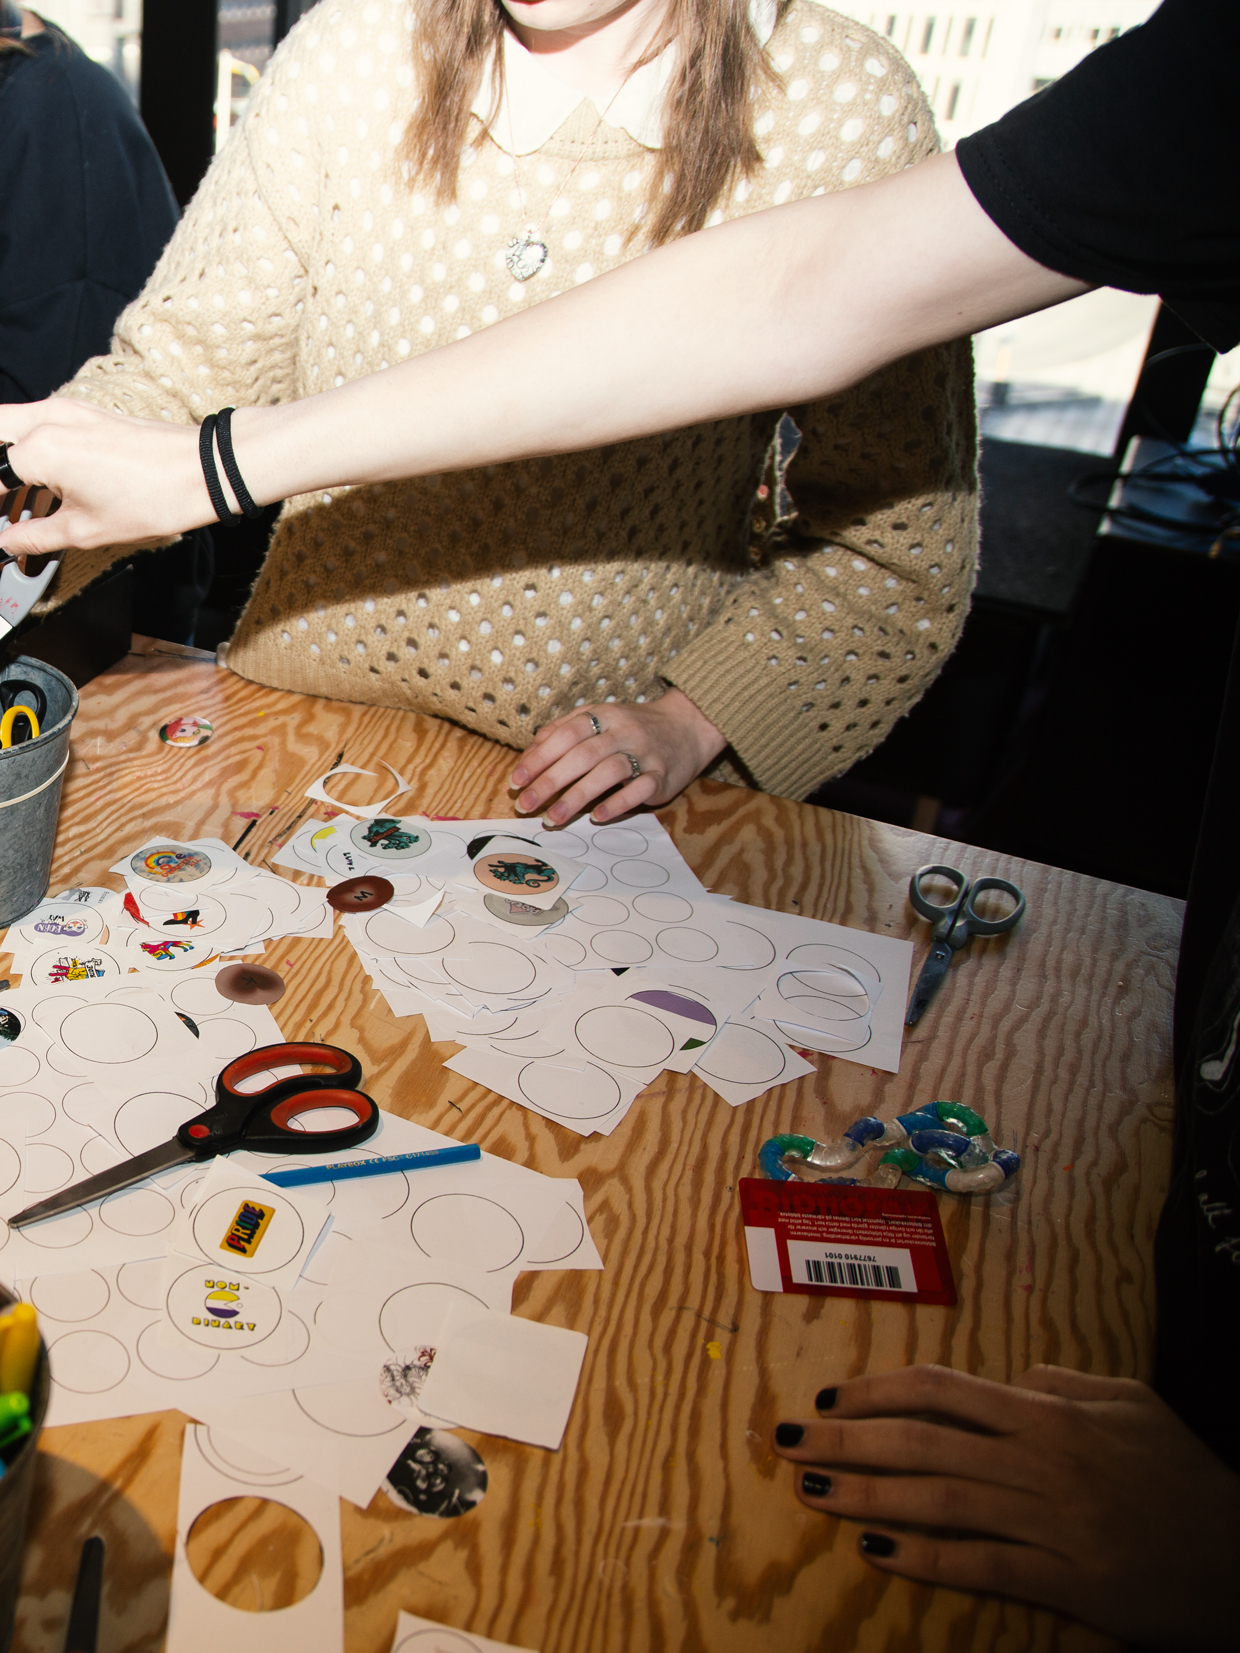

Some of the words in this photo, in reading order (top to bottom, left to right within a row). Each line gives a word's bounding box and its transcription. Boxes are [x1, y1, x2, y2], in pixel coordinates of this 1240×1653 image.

[37, 923, 61, 934] BORN
[325, 1160, 366, 1171] PLAYBOX
[225, 1203, 271, 1255] PRIDE
[824, 1251, 843, 1260] 0101
[844, 1253, 877, 1262] 7677910
[191, 1316, 257, 1331] BINARY
